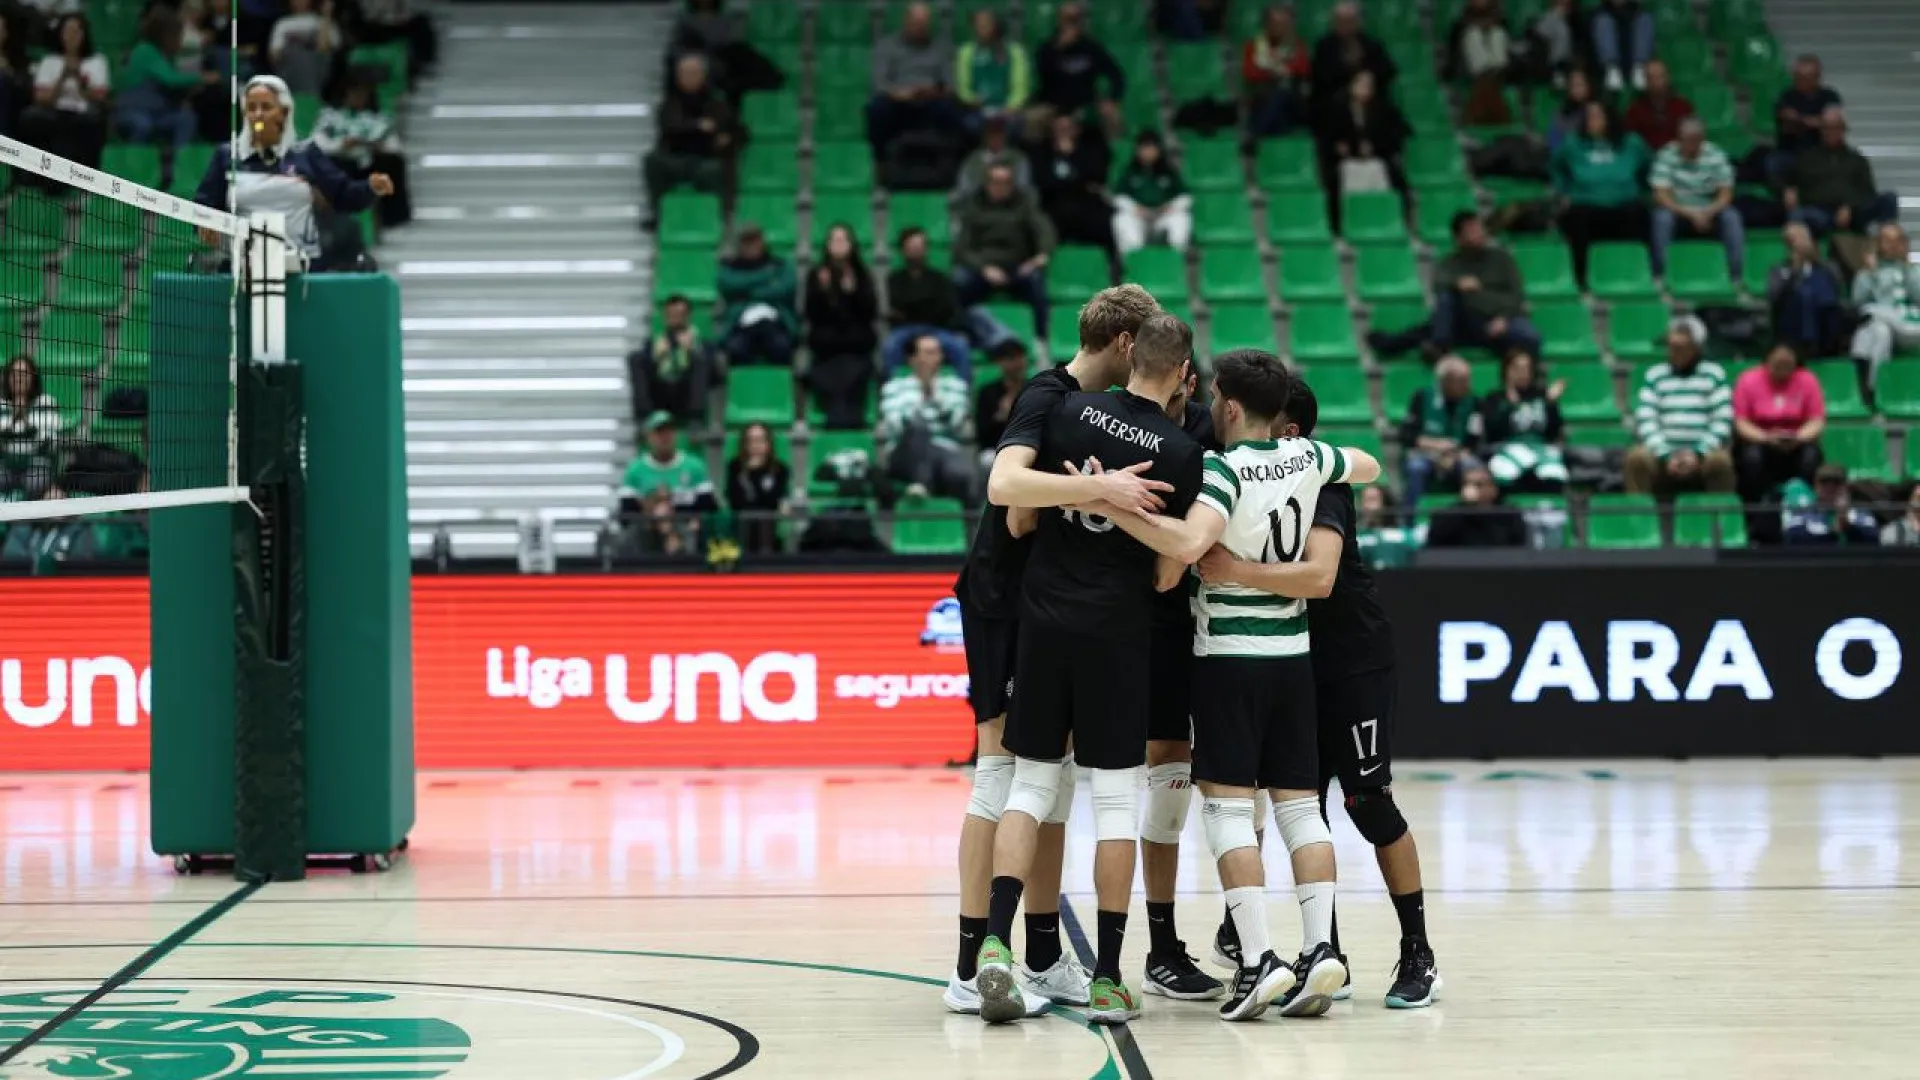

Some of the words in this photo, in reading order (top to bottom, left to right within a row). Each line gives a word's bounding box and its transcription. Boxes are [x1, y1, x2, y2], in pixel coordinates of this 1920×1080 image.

[1080, 406, 1164, 453] POKERSNIK
[1261, 496, 1301, 562] 10
[1, 655, 152, 727] un
[486, 646, 592, 708] Liga
[606, 652, 818, 723] una
[1439, 620, 1774, 702] PARA
[1815, 617, 1902, 700] O
[1351, 718, 1378, 759] 17
